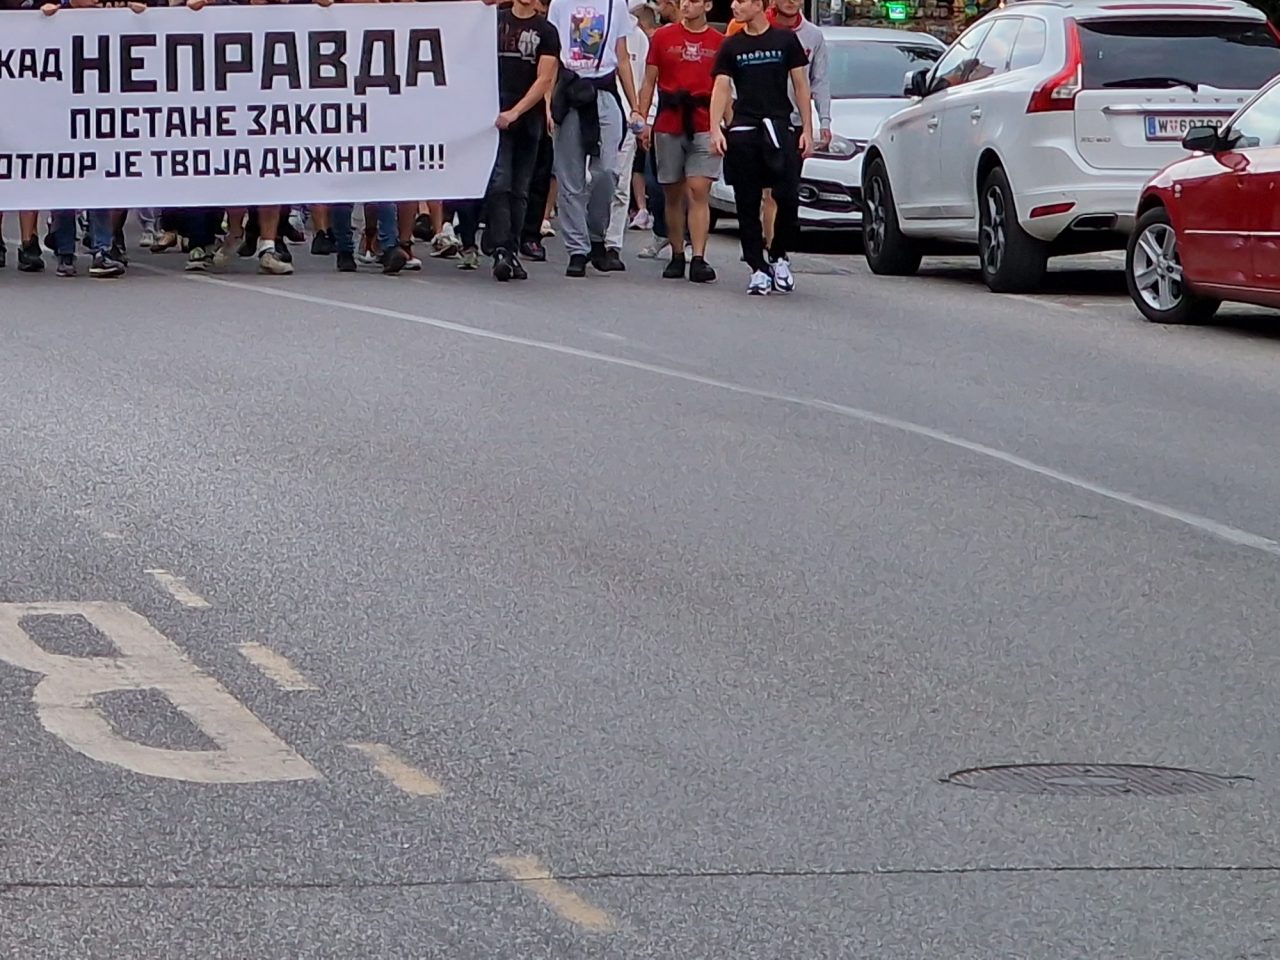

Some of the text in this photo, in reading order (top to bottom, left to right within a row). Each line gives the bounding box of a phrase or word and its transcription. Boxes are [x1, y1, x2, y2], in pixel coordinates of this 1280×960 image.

[72, 28, 447, 95] НЕПРАВДА
[70, 102, 367, 139] ПОСТАНЕ ЗАКОН
[1158, 120, 1168, 133] W
[104, 150, 142, 178] ЈЕ
[150, 148, 252, 177] ТВОЈА
[259, 144, 445, 178] ДУЖНОСТ!!!
